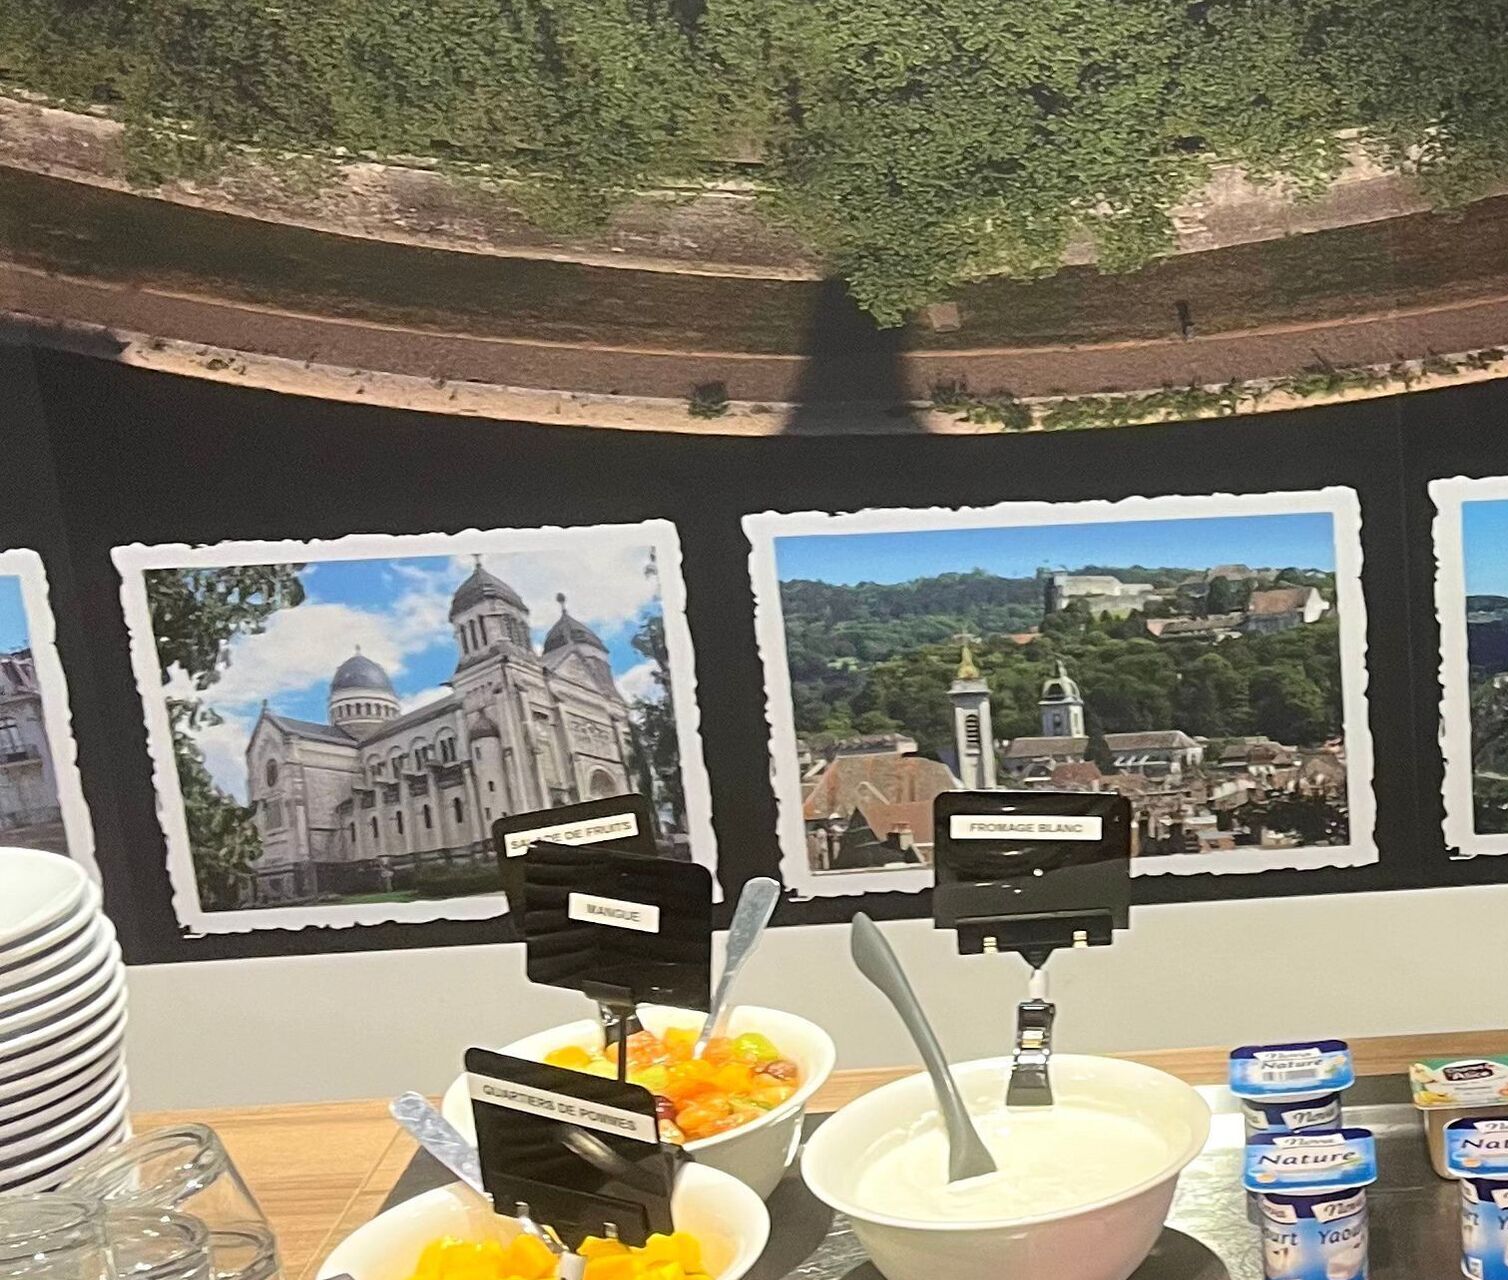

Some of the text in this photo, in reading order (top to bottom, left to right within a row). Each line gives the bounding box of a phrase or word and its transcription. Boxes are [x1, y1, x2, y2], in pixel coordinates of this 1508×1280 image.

[564, 829, 583, 840] DE
[586, 822, 632, 837] FRUITS
[969, 822, 1083, 834] FROMAGE BLANC
[586, 903, 641, 922] MANGUE
[1261, 1059, 1323, 1071] Nature
[482, 1084, 638, 1131] QUARTIERS DE POMMES
[1258, 1150, 1357, 1166] Nature
